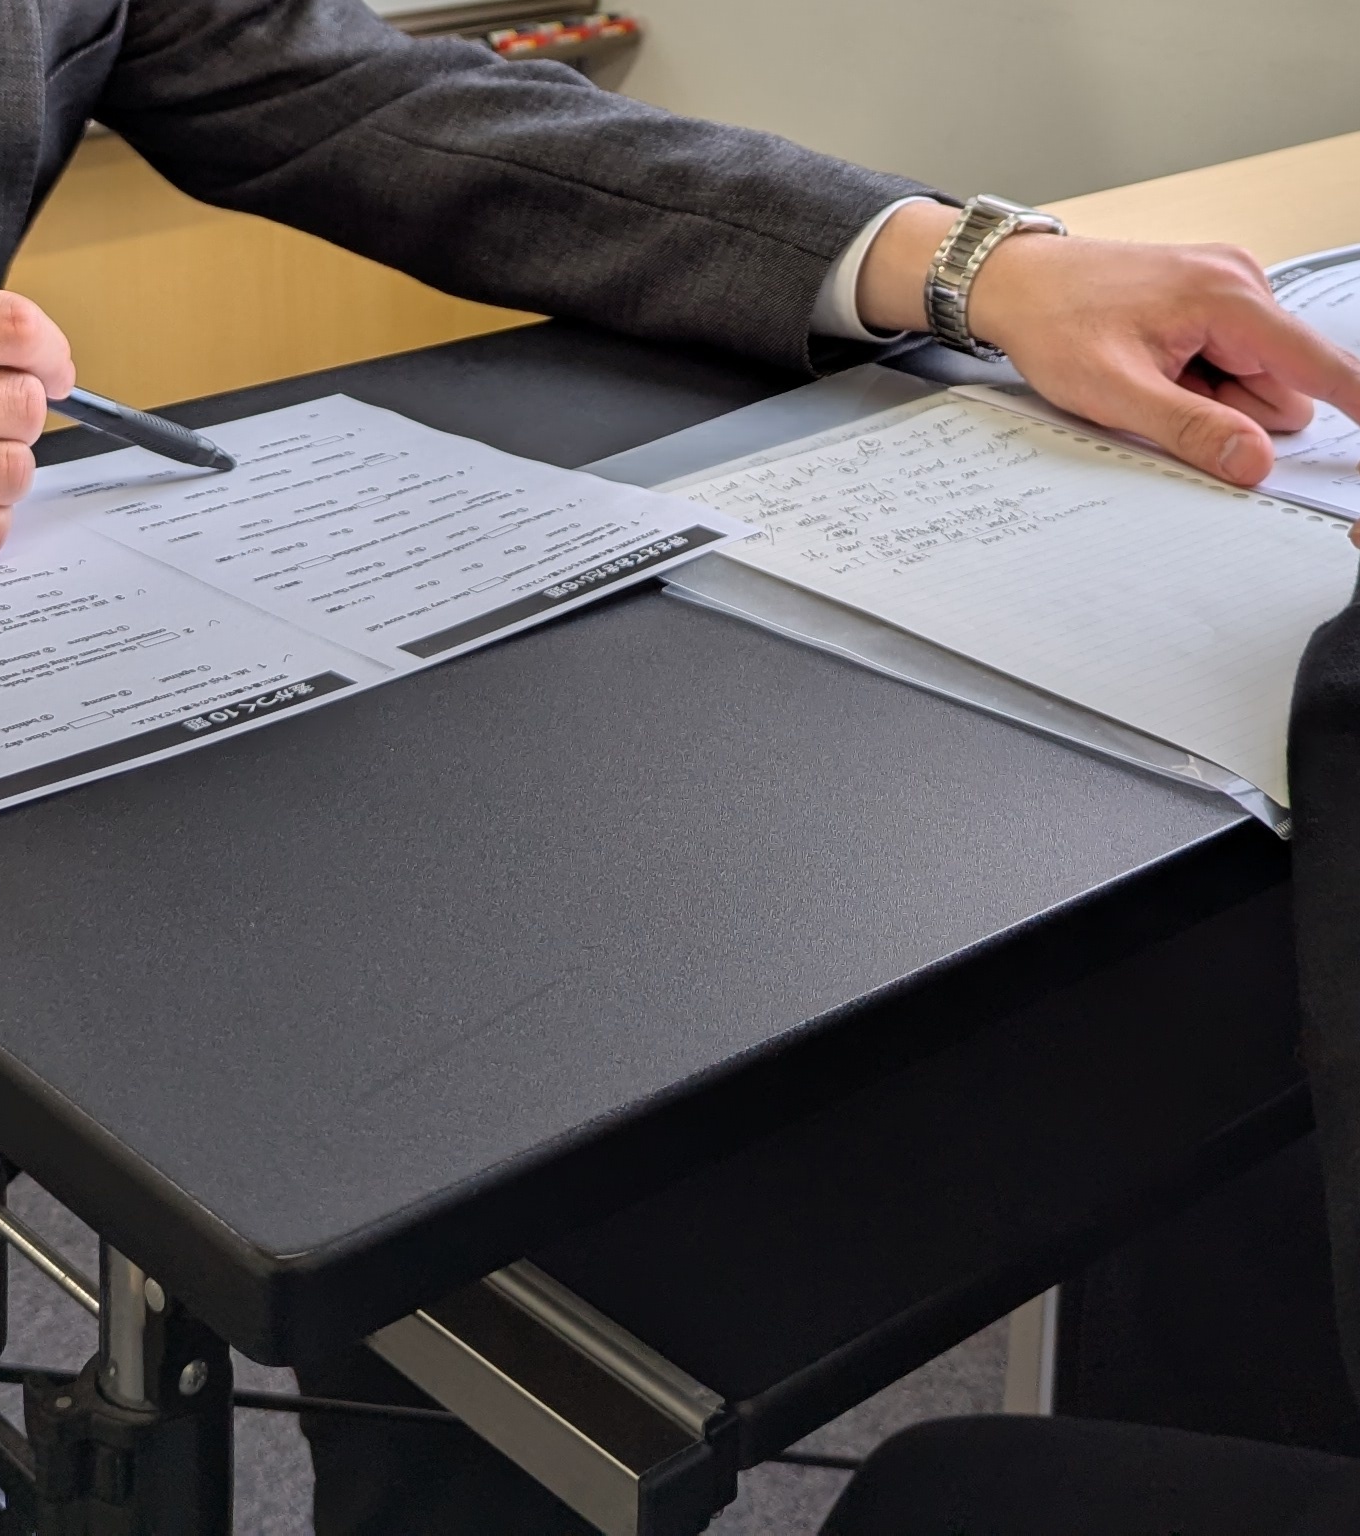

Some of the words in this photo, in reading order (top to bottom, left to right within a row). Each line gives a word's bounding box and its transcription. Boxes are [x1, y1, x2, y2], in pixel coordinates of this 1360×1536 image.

[183, 682, 315, 732] 差がつく10題
